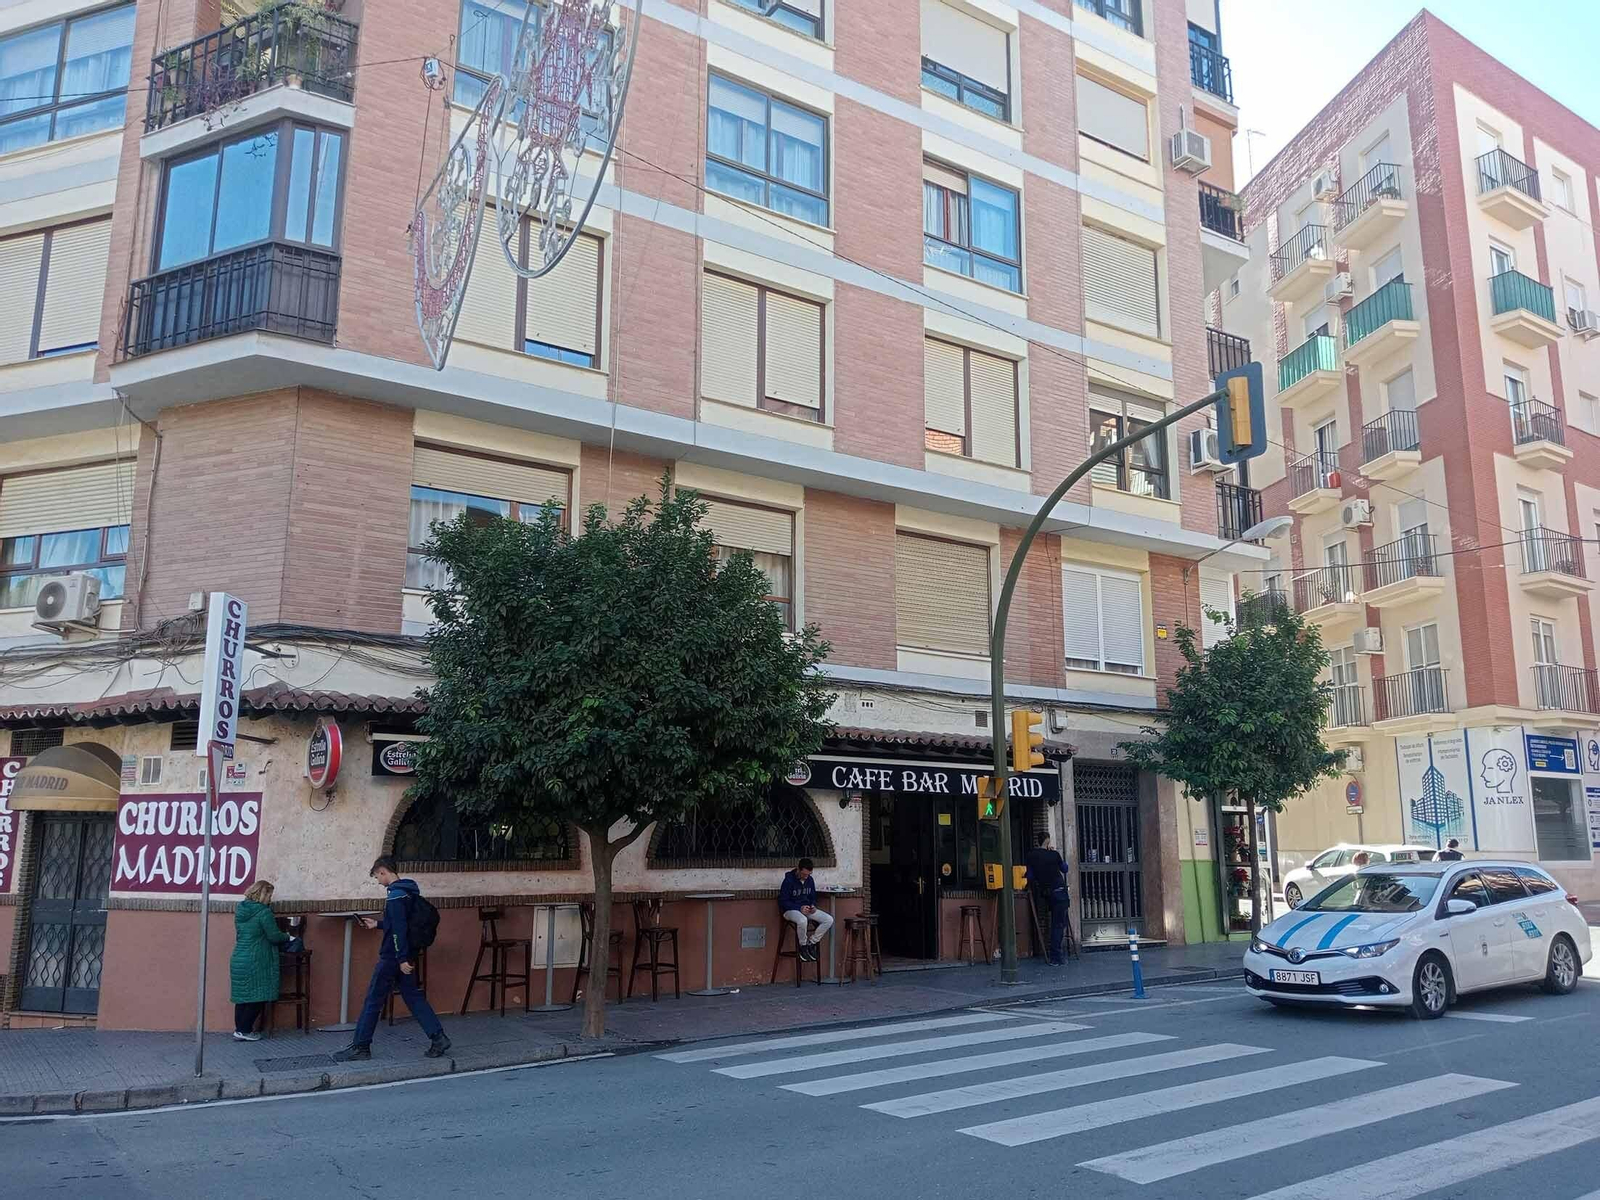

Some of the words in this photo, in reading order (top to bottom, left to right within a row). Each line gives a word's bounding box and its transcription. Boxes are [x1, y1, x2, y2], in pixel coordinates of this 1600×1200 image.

[216, 600, 242, 740] CHURROS
[27, 775, 69, 790] MADRID
[832, 765, 895, 791] CAFE
[902, 770, 950, 793] BAR
[961, 774, 1043, 798] MRID
[1483, 796, 1524, 805] JANLEX
[1276, 971, 1297, 982] 8871
[1300, 973, 1316, 983] JSF
